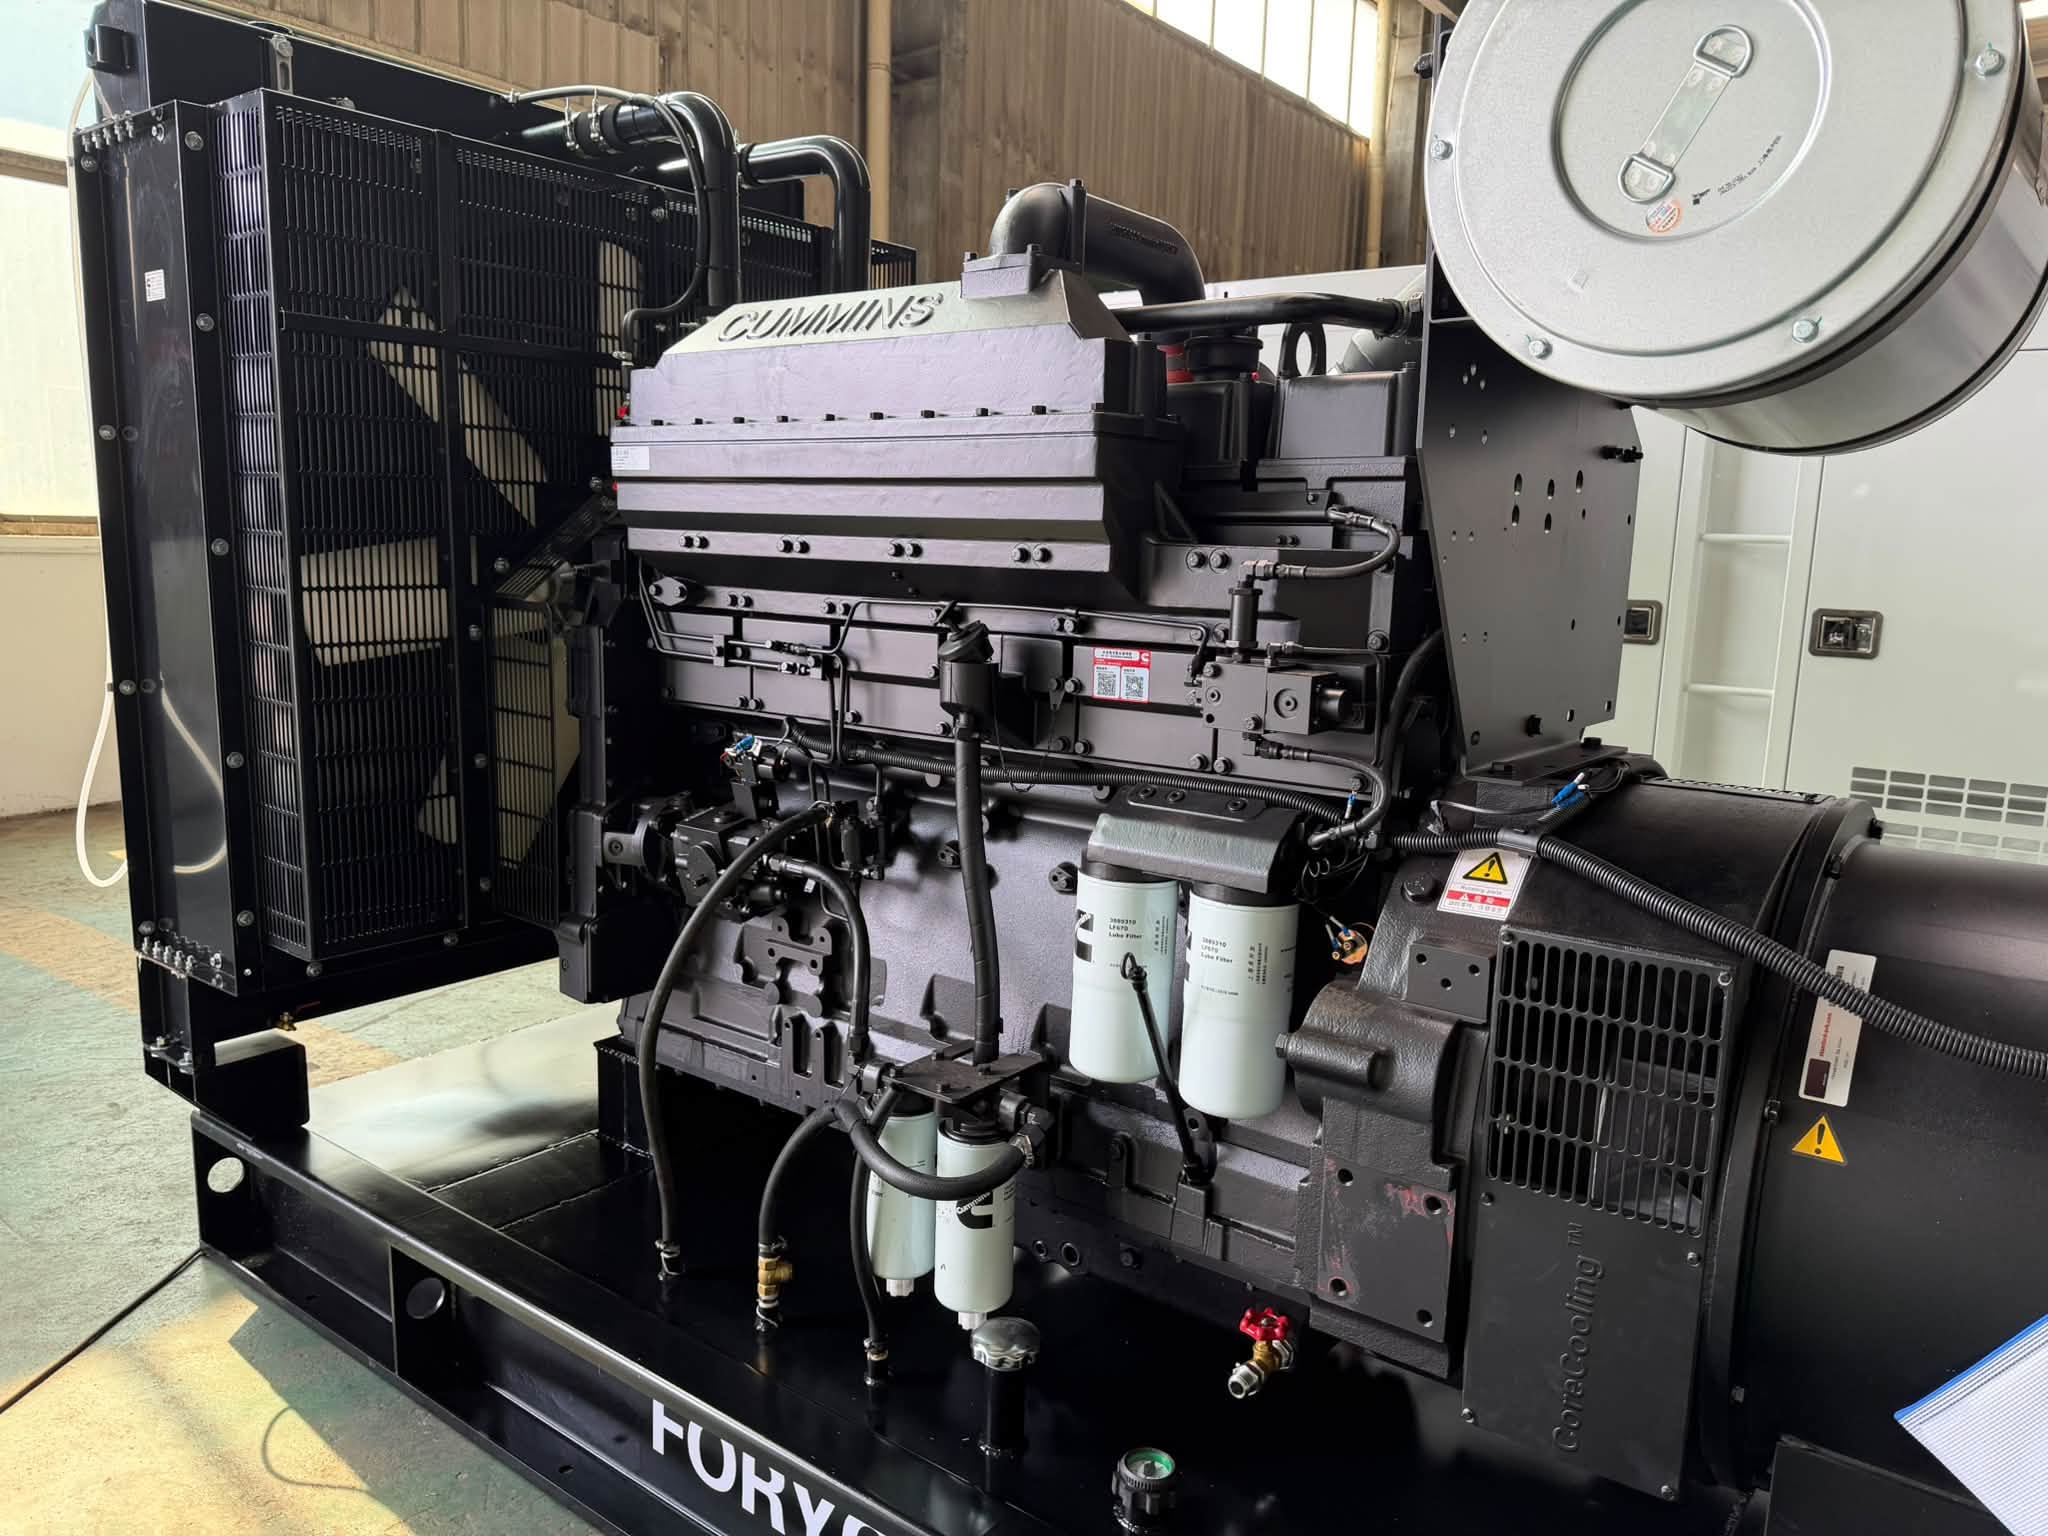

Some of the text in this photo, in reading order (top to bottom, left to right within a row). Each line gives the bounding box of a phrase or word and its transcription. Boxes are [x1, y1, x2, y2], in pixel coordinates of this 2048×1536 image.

[718, 293, 944, 342] CUMMINS
[957, 1191, 991, 1215] Cummins
[1552, 1254, 1604, 1452] CoraCooling
[653, 1398, 885, 1536] FORY
